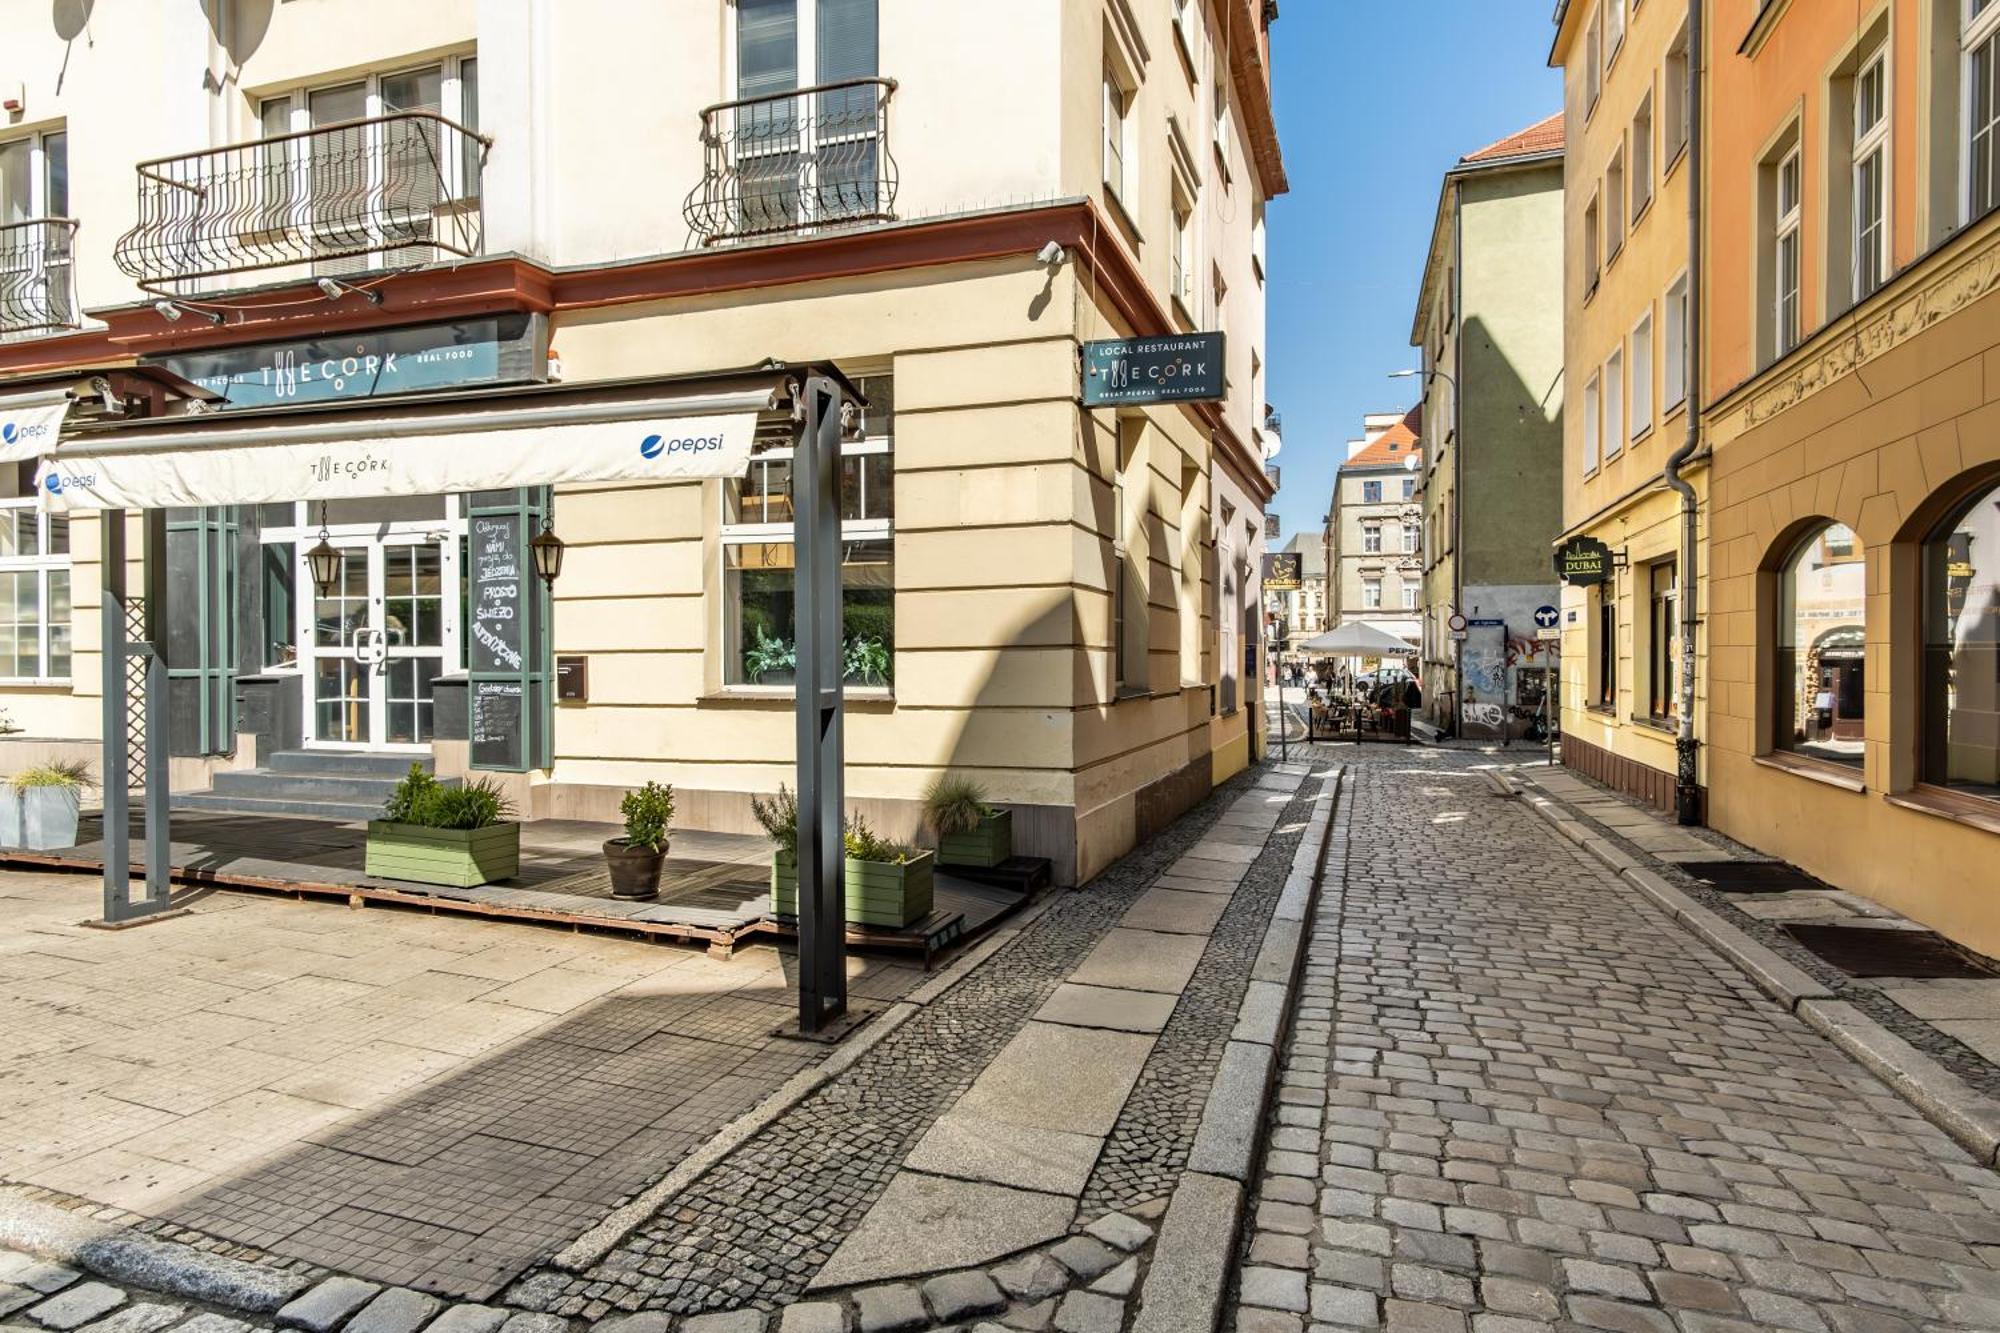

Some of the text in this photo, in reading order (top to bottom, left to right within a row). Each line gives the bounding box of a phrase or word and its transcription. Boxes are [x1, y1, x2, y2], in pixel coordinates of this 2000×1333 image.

[445, 350, 473, 360] FOOD
[1100, 340, 1206, 356] LOCAL RESTAURANT
[321, 348, 397, 387] CORK
[1148, 360, 1207, 383] CORK
[20, 424, 49, 439] peps
[667, 433, 724, 455] pepsi
[345, 457, 387, 477] CORK
[62, 473, 97, 490] pepsi
[1567, 560, 1602, 571] DUBAI
[483, 584, 518, 600] PROSTO
[1388, 647, 1418, 655] PEPSI
